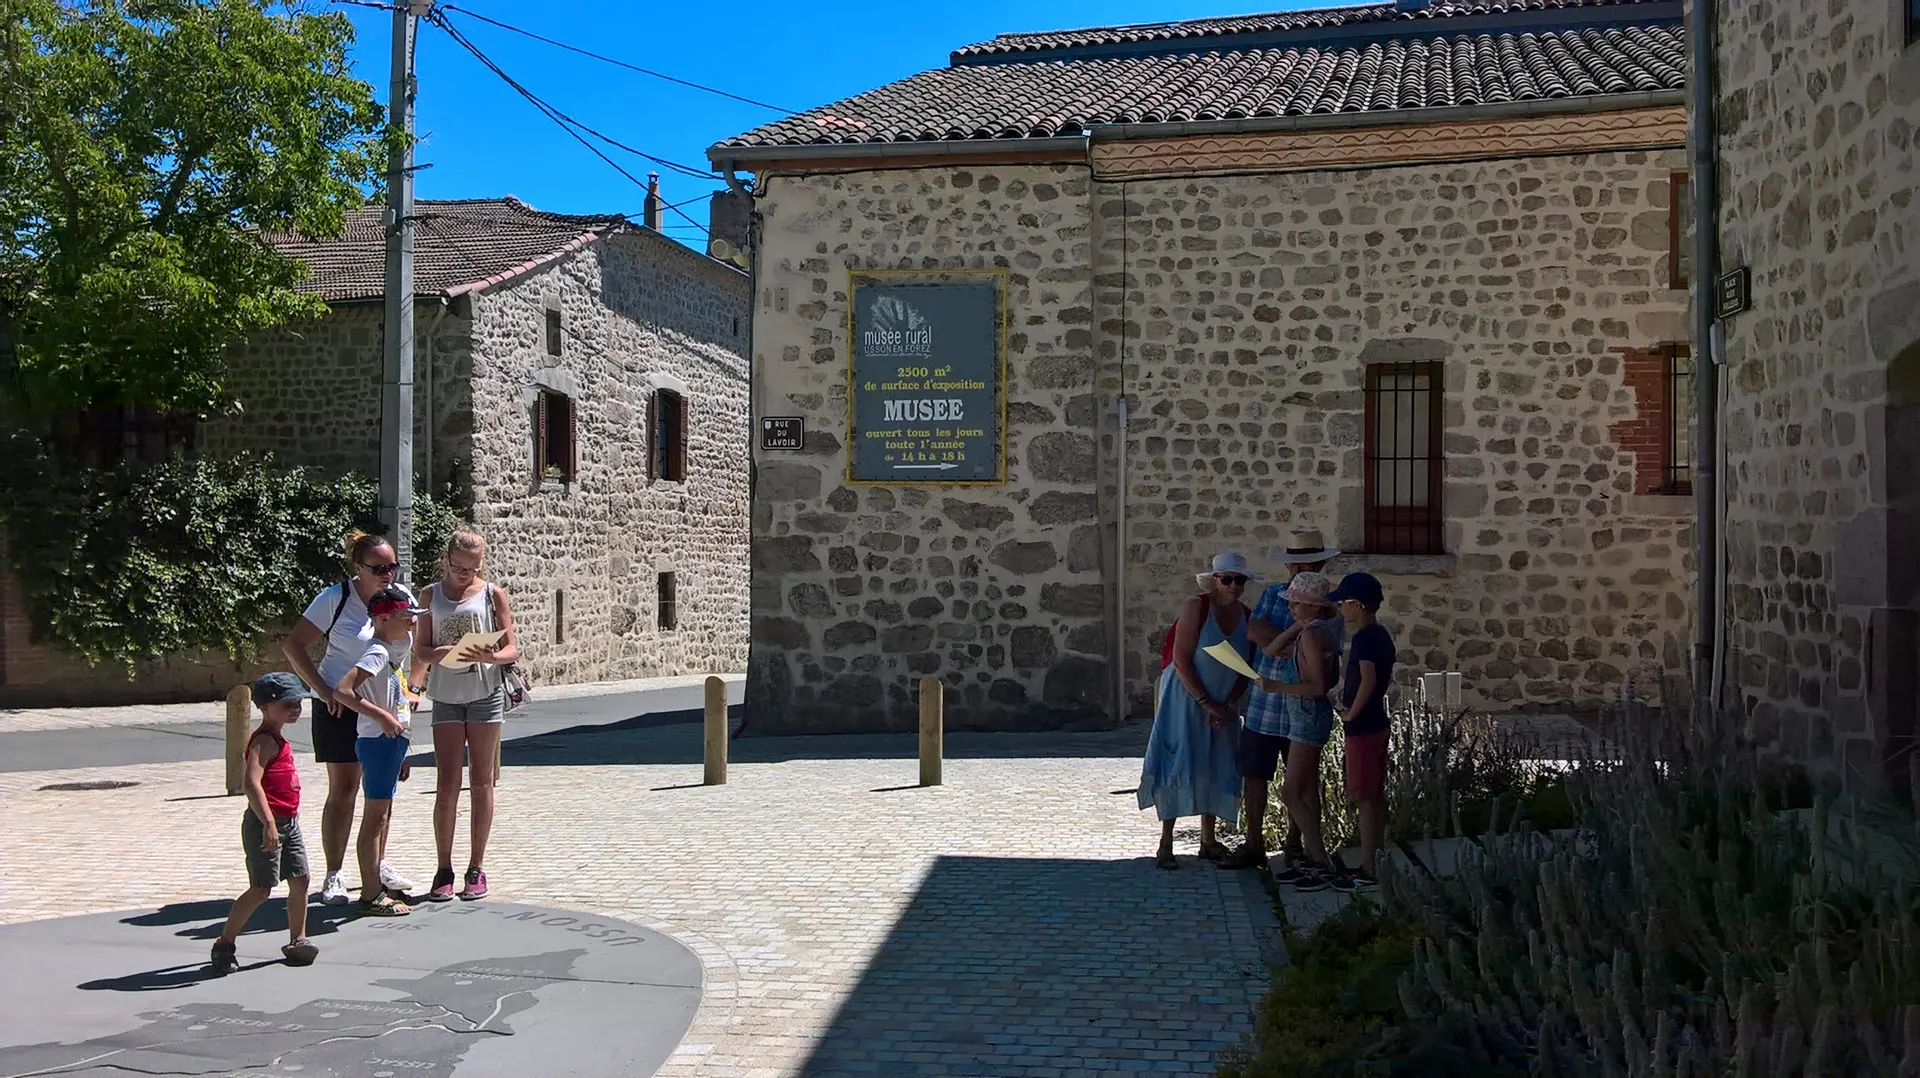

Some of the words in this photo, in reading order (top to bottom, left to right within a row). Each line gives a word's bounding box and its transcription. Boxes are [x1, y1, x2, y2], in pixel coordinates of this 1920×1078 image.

[864, 326, 902, 346] musée
[905, 325, 932, 345] rural
[864, 345, 892, 354] USSON
[905, 345, 931, 353] FOREZ
[897, 367, 929, 378] 2500
[864, 381, 877, 391] de
[881, 380, 920, 390] surface
[923, 379, 985, 392] d'exposition
[883, 399, 964, 422] MUSEE
[774, 420, 789, 428] RUE
[865, 429, 903, 438] ouvert
[906, 428, 931, 437] tous
[936, 427, 952, 437] les
[954, 427, 985, 439] jours
[767, 438, 796, 446] LAVOIR
[885, 440, 915, 449] toute
[884, 453, 895, 461] de
[901, 452, 915, 462] 14
[918, 452, 926, 461] h
[929, 451, 937, 461] à
[942, 451, 955, 461] 18
[957, 450, 966, 461] h
[368, 921, 429, 931] SUD
